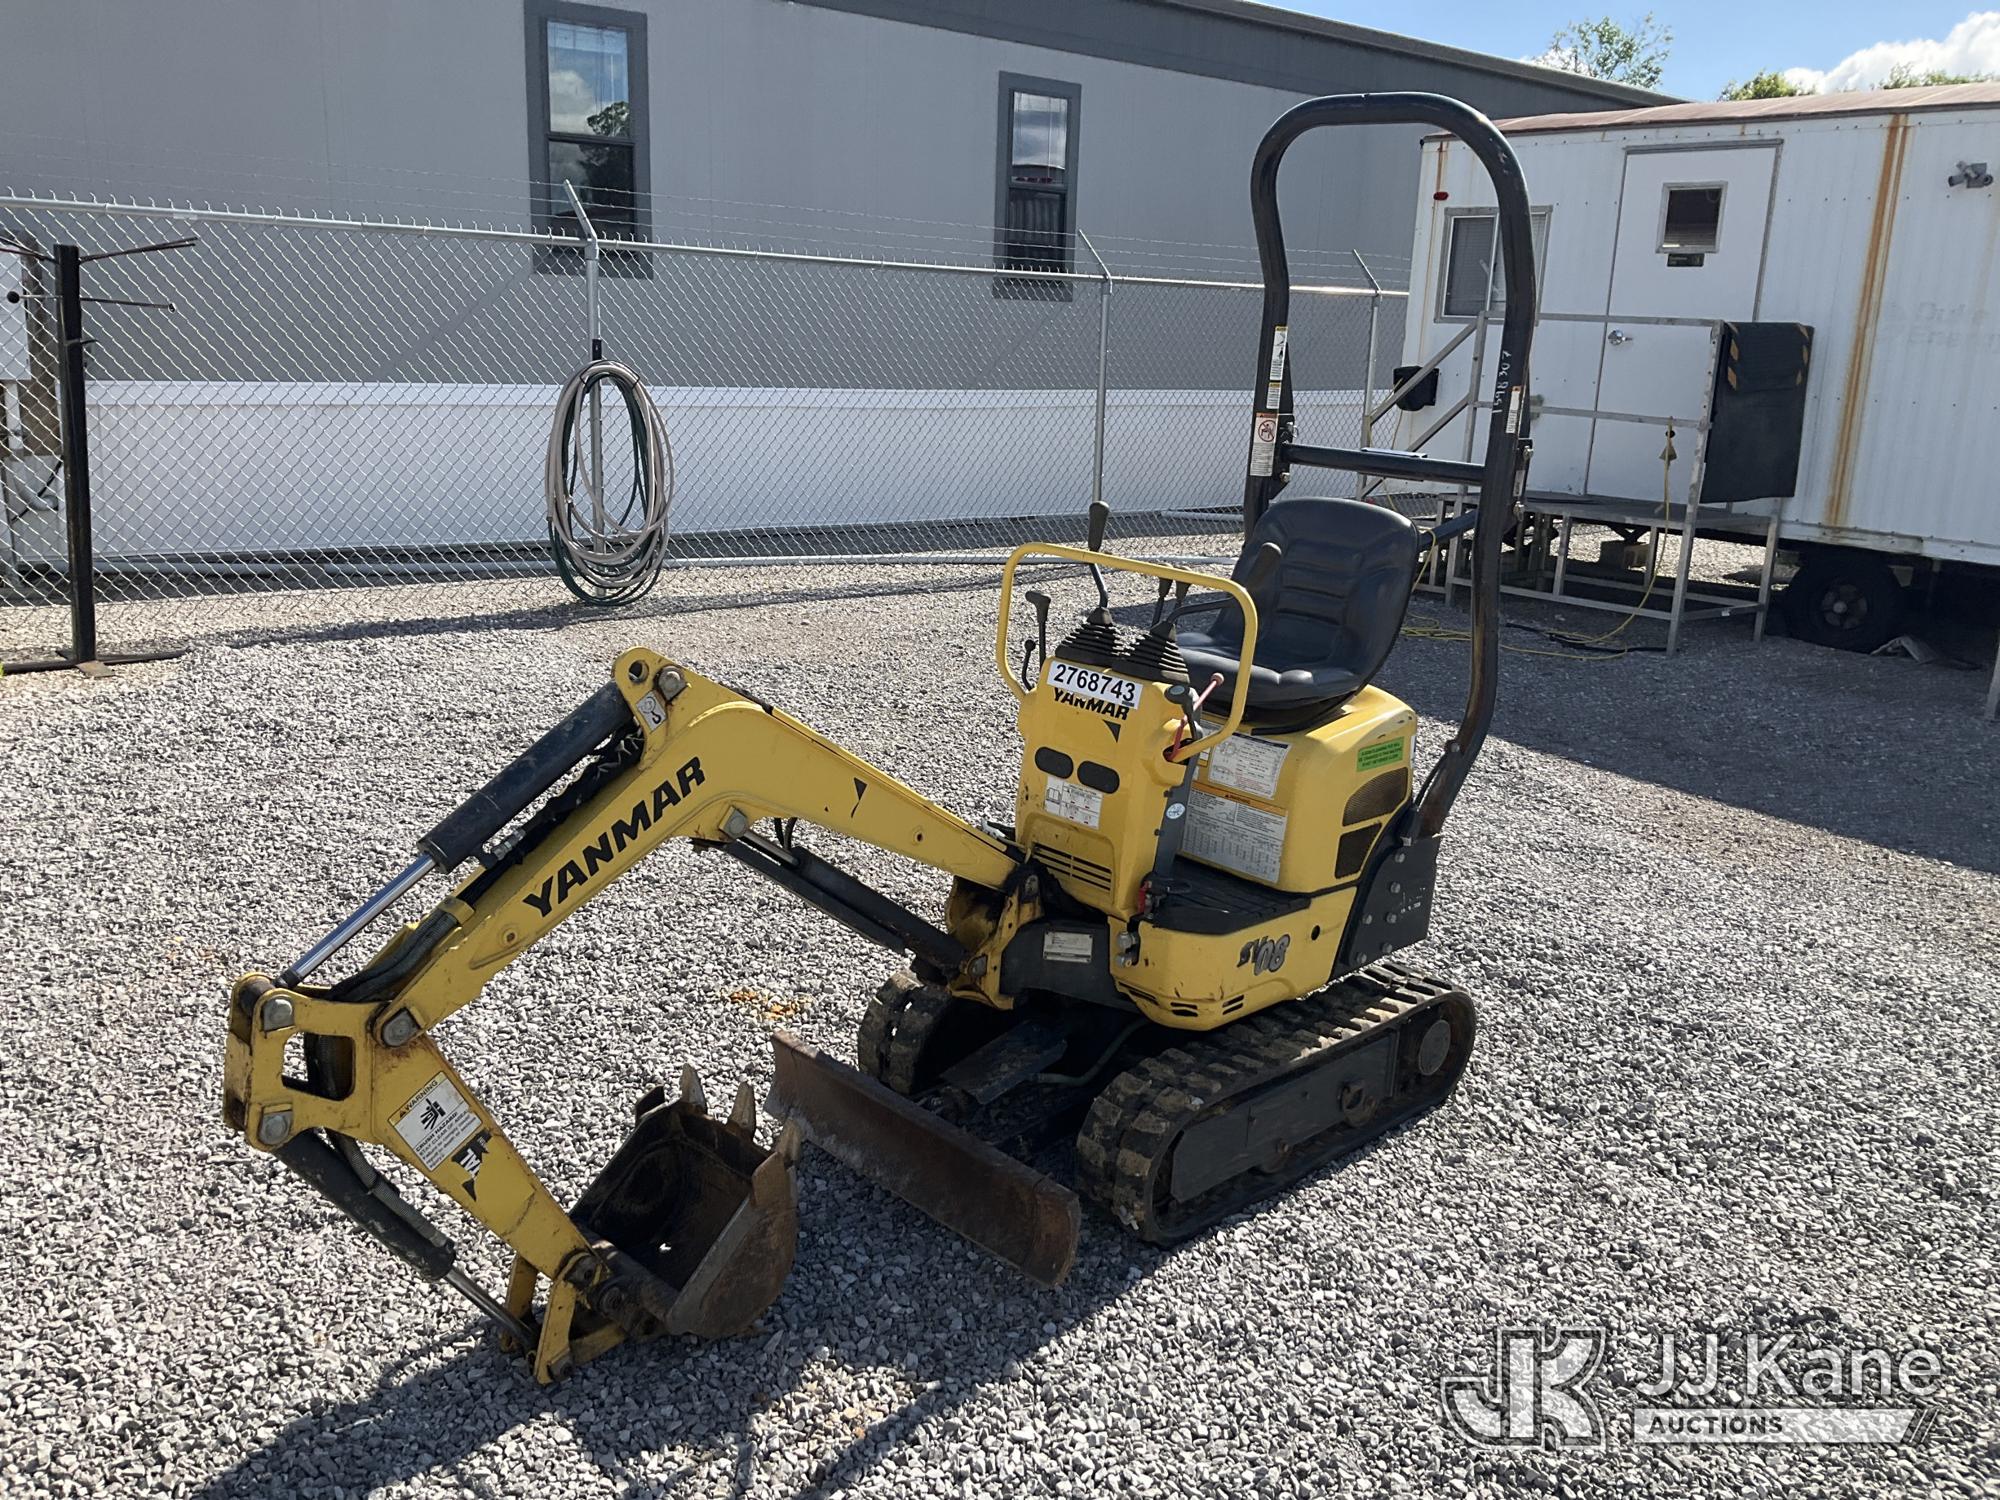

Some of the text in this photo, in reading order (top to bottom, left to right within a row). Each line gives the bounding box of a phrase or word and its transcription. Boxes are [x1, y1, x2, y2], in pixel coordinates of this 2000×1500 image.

[1053, 664, 1136, 702] 2768743
[1053, 687, 1130, 721] YANMAR
[522, 756, 706, 918] YANMAR
[403, 1079, 438, 1112] WARNING
